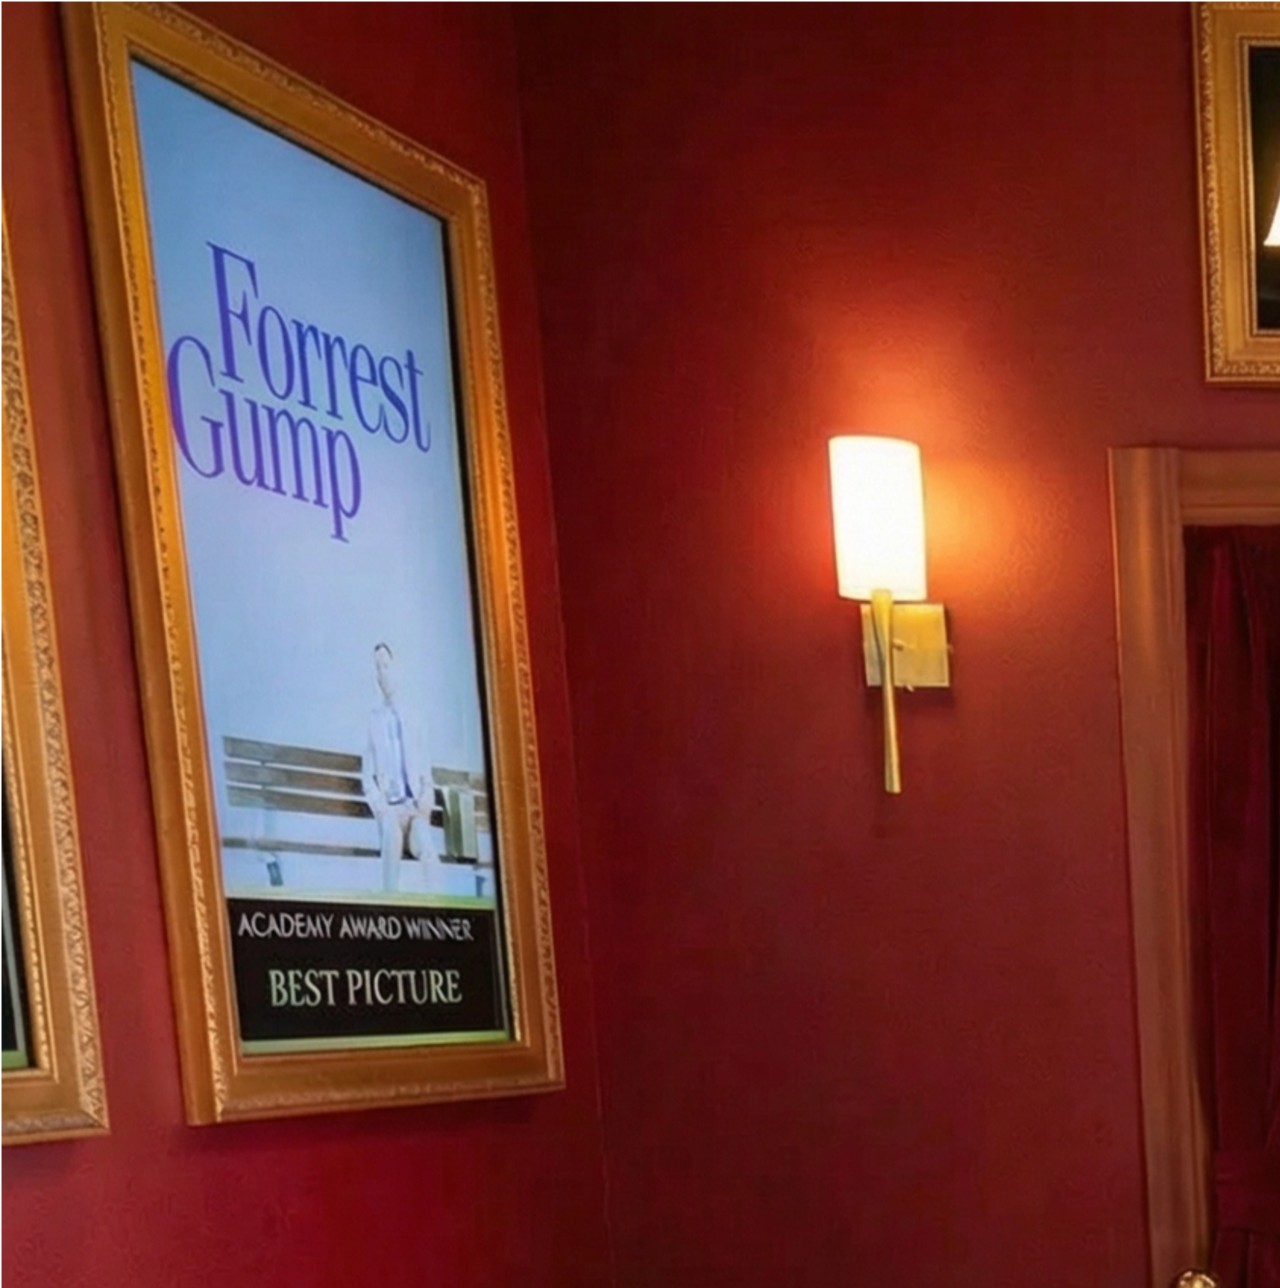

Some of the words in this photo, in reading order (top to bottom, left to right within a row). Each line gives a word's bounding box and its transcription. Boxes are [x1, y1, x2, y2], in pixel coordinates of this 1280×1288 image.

[206, 241, 431, 453] Forrest
[167, 335, 362, 543] Gump
[237, 912, 334, 939] ACADEMY
[338, 914, 402, 941] AWARD
[403, 916, 475, 942] WINNER
[268, 969, 340, 1008] BEST
[346, 968, 463, 1006] PICTURE
